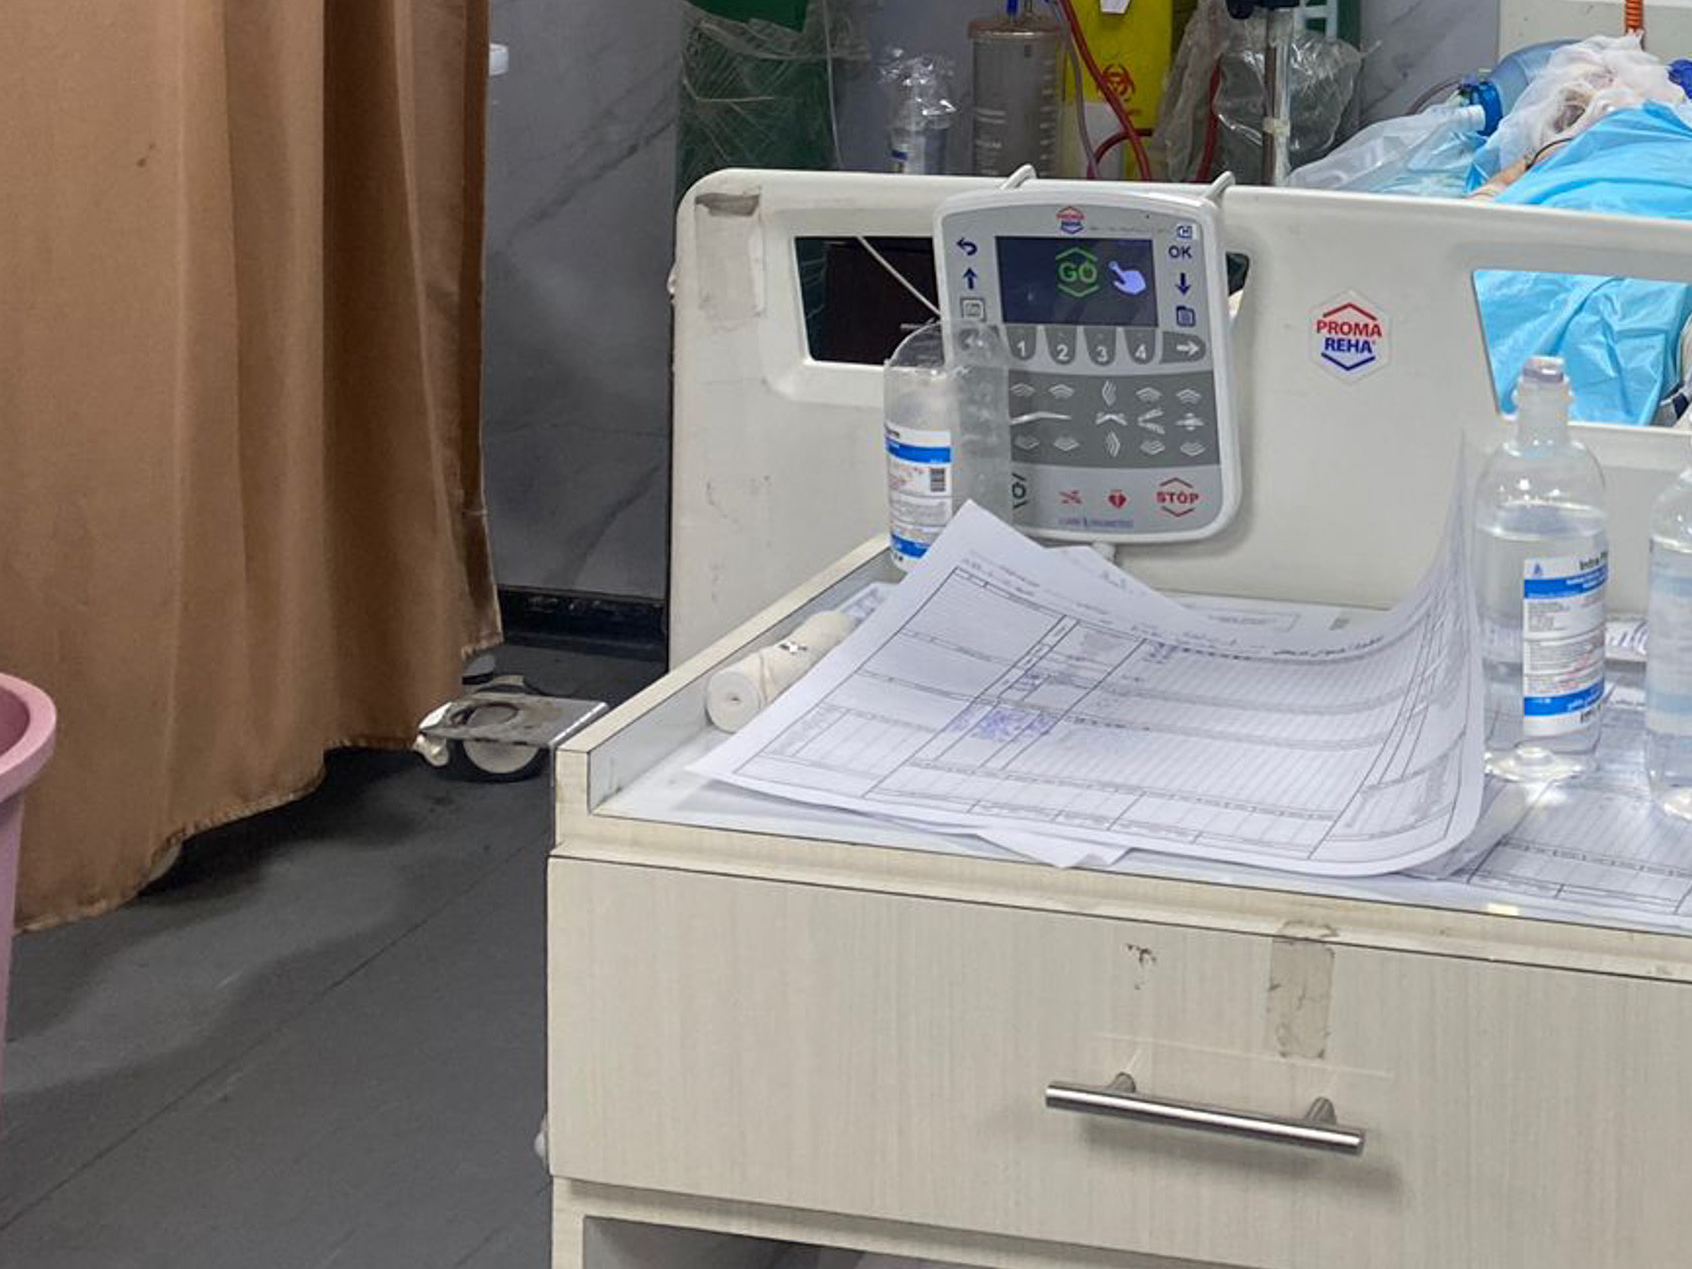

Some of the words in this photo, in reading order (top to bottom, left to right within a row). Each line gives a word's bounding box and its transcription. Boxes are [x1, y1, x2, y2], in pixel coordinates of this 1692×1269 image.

[1168, 245, 1193, 259] OK
[1058, 260, 1098, 283] GO
[1316, 320, 1382, 338] PROMA
[1017, 340, 1026, 358] 1
[1056, 344, 1070, 362] 2
[1096, 346, 1109, 363] 3
[1134, 343, 1147, 361] 4
[1324, 337, 1373, 354] REHA
[1156, 491, 1200, 505] STOP
